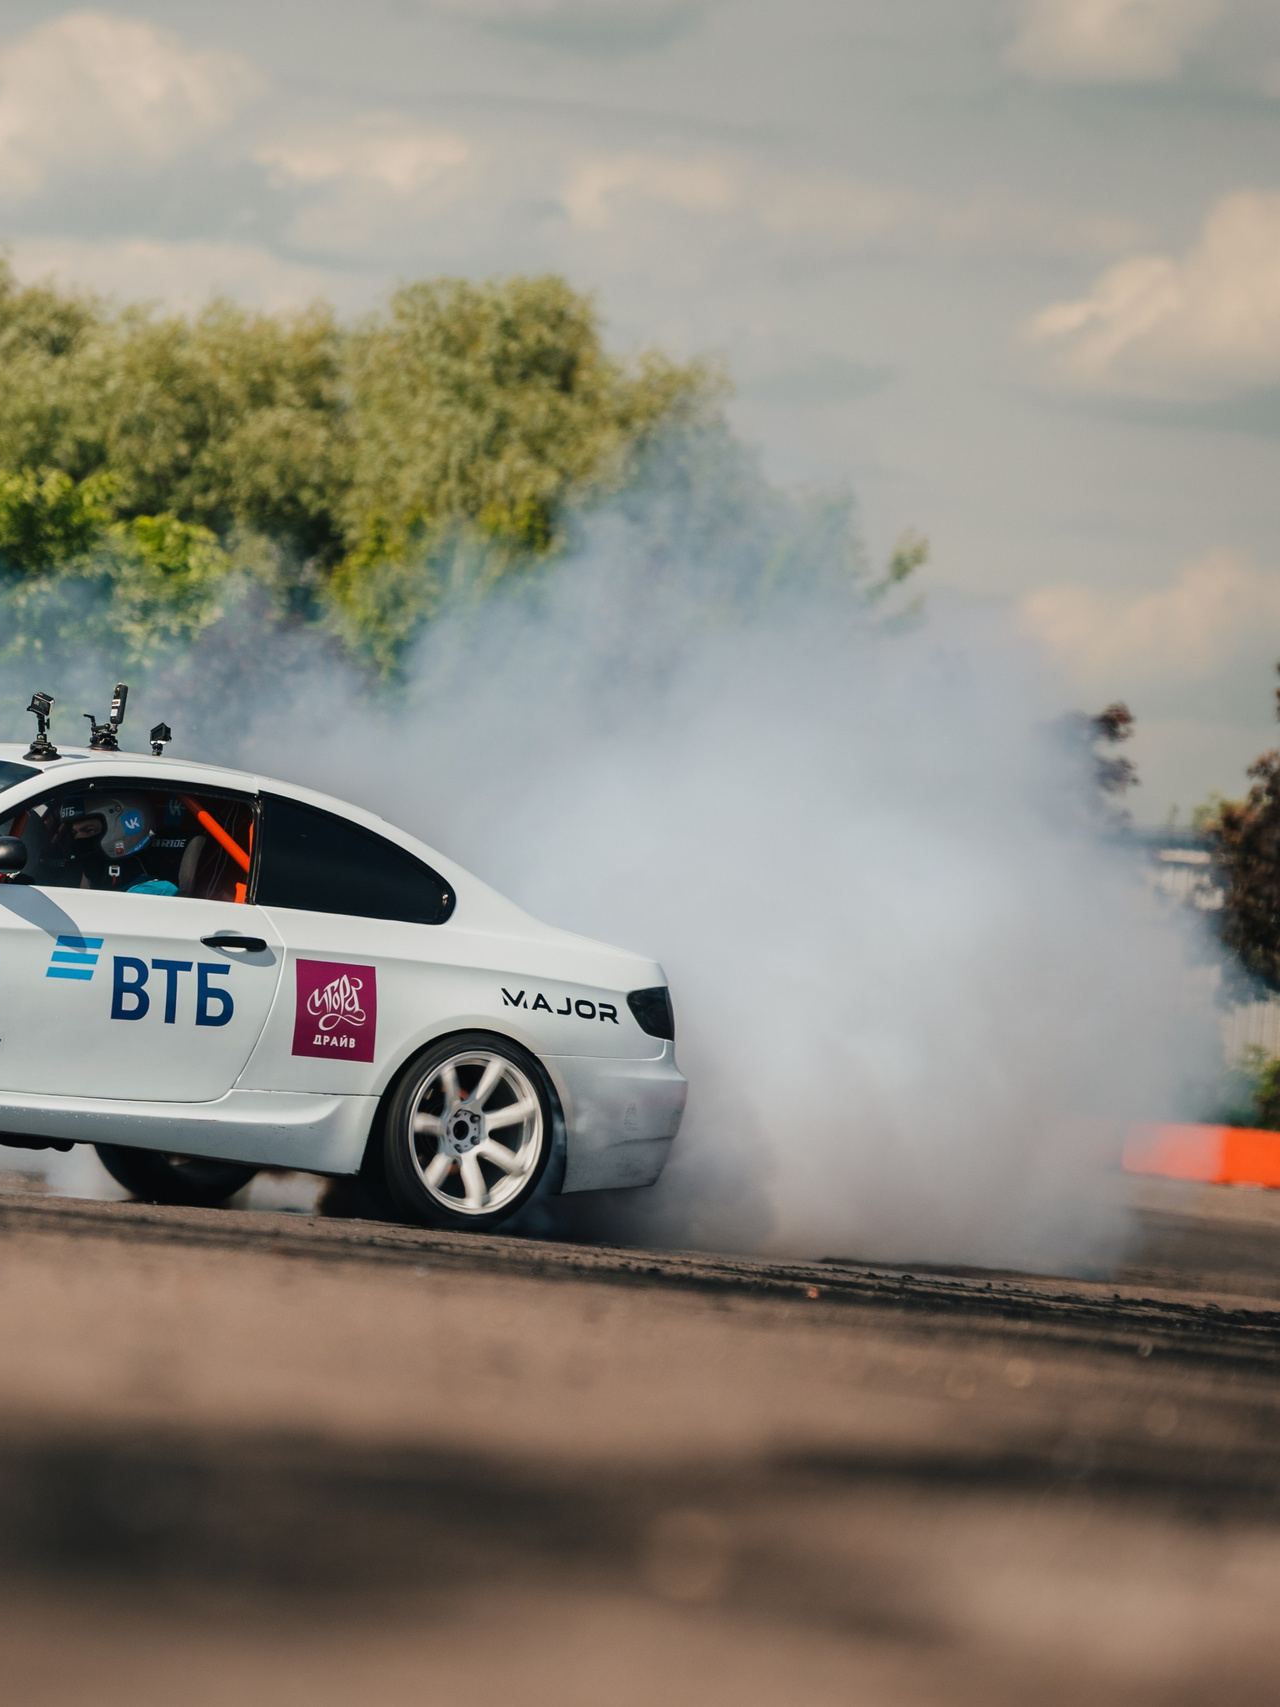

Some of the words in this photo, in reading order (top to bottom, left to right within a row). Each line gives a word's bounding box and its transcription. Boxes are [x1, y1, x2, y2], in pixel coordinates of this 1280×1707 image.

[125, 817, 140, 830] VK
[152, 838, 187, 848] BRIDE
[110, 955, 235, 1027] ВТБ
[500, 987, 620, 1025] MAJOR
[312, 1034, 356, 1049] ДРАЙВ
